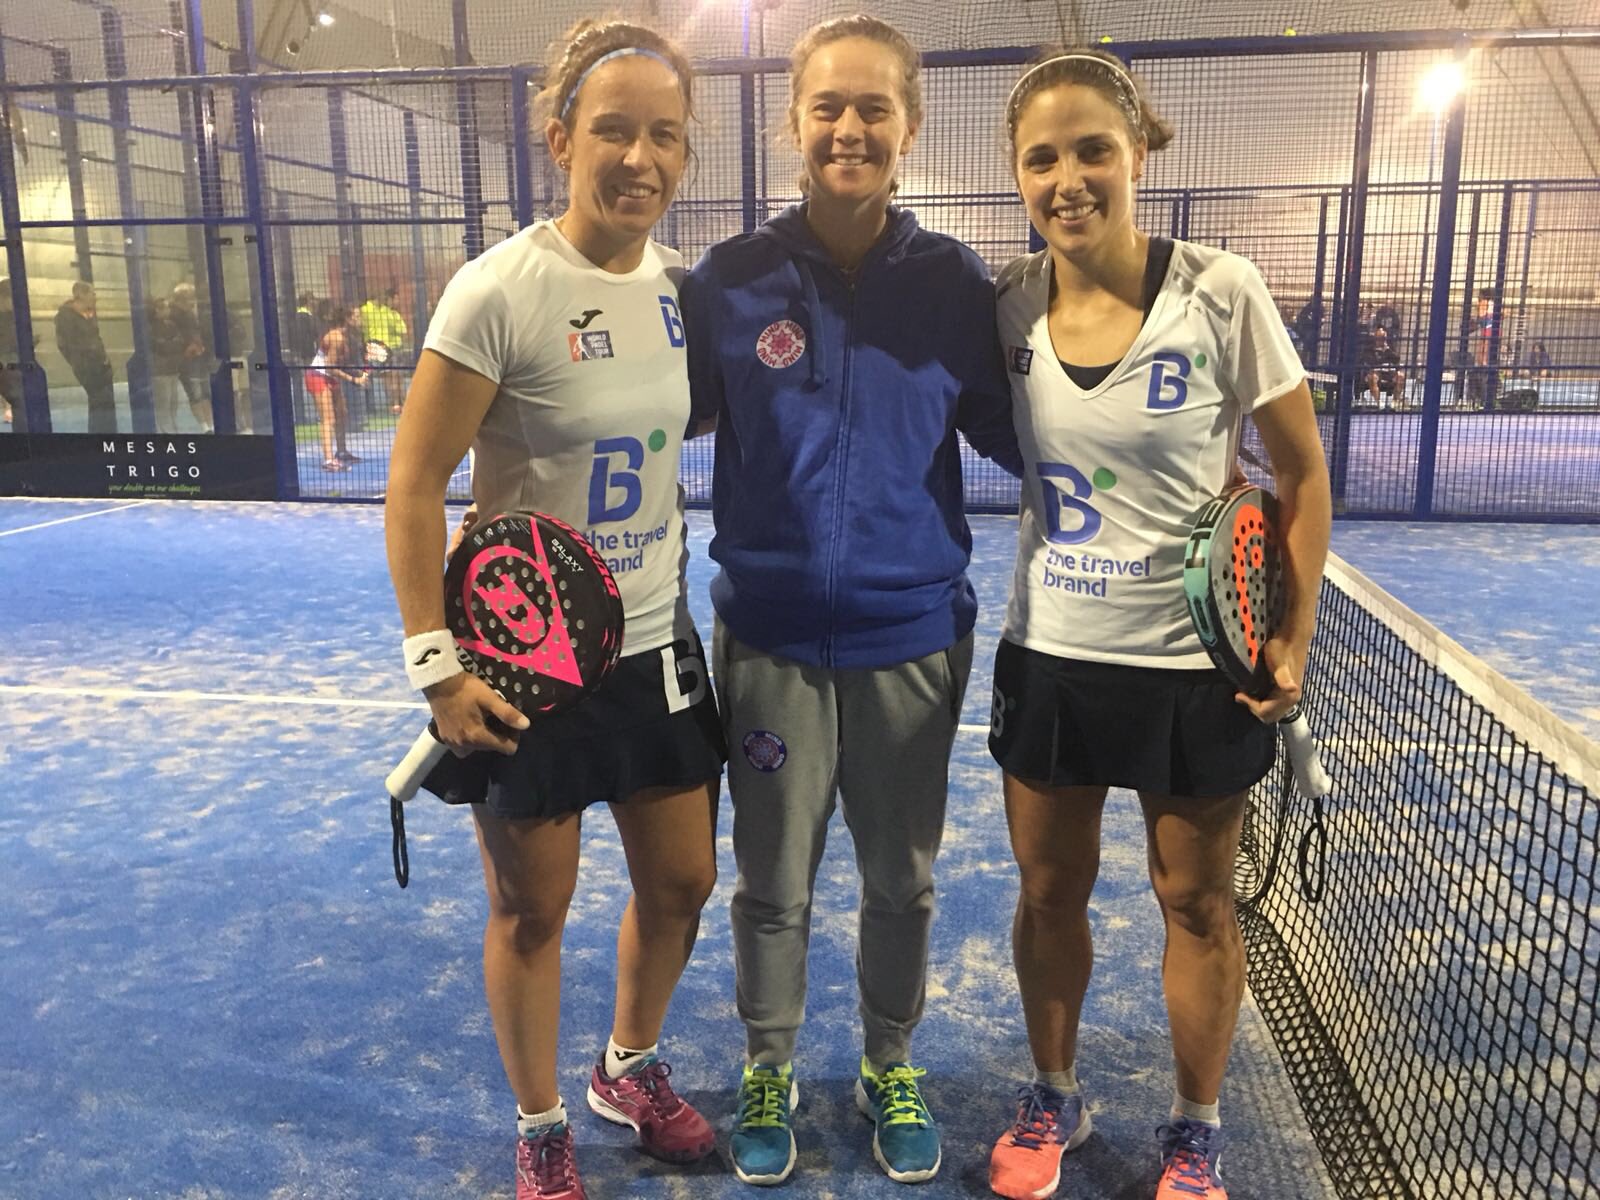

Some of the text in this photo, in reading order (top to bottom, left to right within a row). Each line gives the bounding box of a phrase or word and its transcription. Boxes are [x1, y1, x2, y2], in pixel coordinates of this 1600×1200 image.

[102, 441, 197, 454] MESAS
[106, 465, 200, 478] TRIGO
[622, 519, 668, 549] travel
[551, 538, 584, 572] GALAXY
[604, 548, 644, 573] and
[1046, 547, 1151, 577] the travel
[1043, 566, 1107, 597] brand
